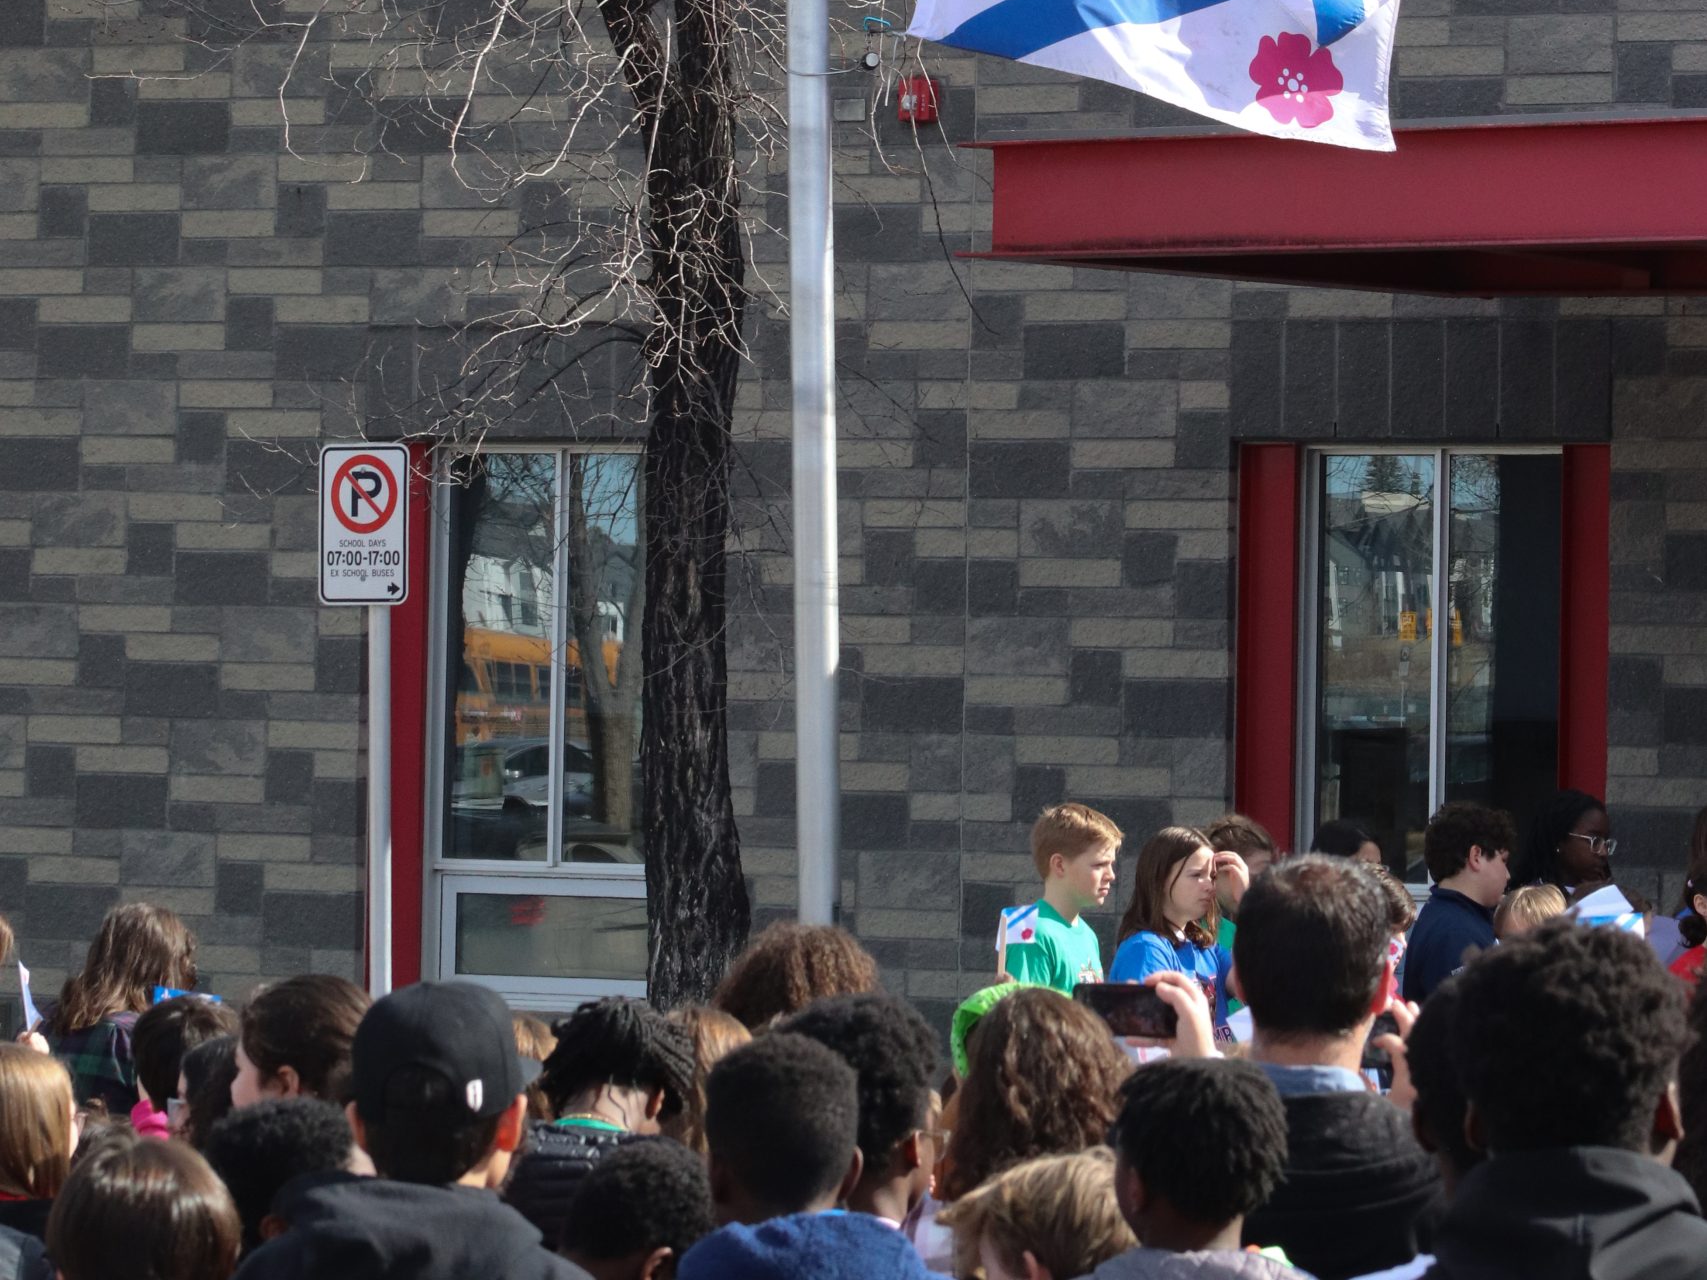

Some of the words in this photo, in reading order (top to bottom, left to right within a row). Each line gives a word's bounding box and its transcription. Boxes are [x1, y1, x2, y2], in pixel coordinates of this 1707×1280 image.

[339, 539, 365, 547] SCHOOL
[369, 539, 386, 547] DAYS
[327, 550, 400, 566] 07:00-17:00
[330, 569, 339, 577] EX
[342, 569, 368, 577] SCHOOL
[372, 569, 395, 577] BUSES
